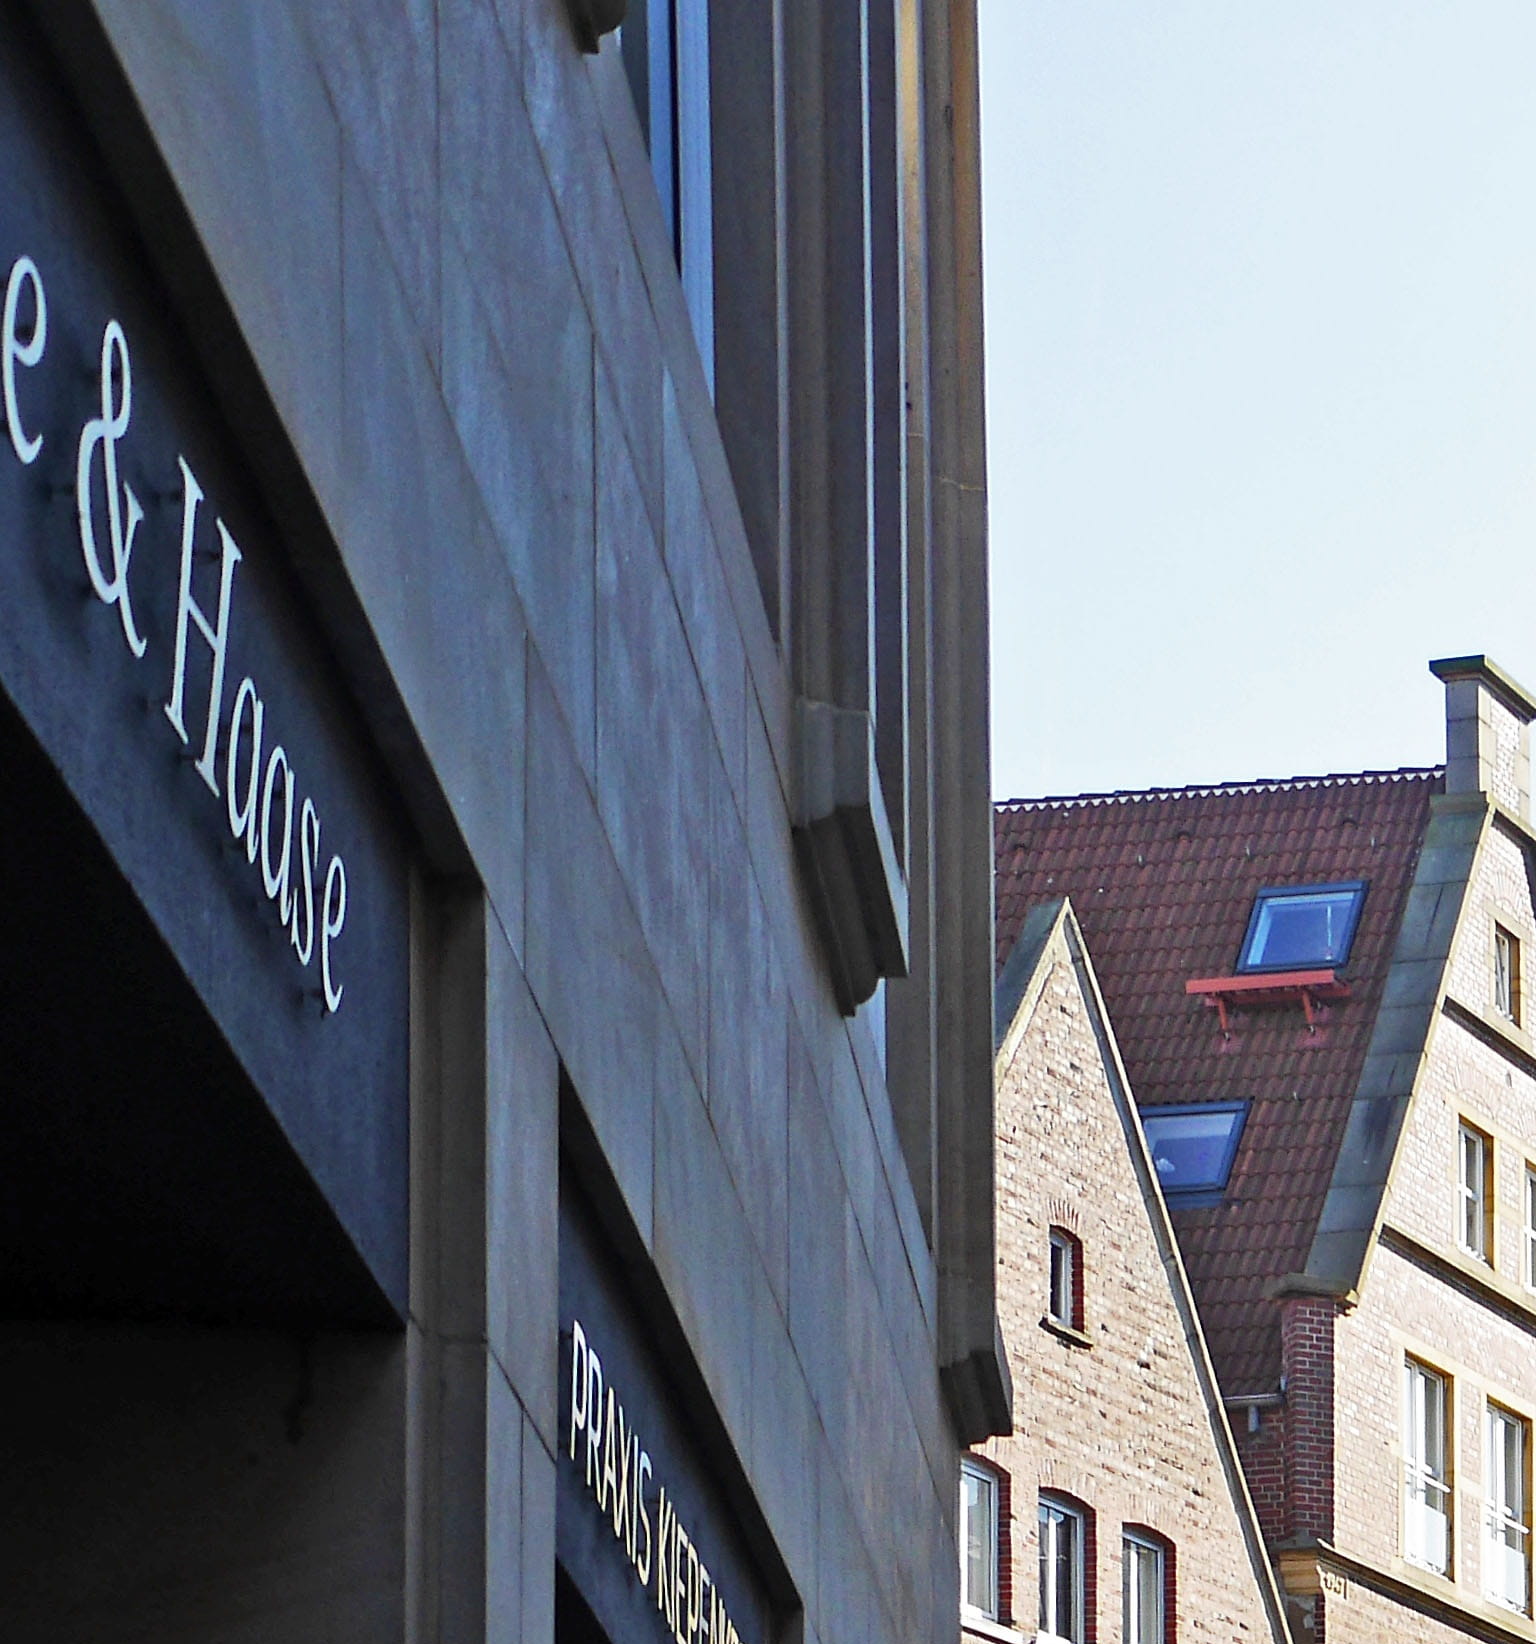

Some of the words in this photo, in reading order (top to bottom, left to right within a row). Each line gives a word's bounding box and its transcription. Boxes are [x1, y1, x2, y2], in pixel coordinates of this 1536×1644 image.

[77, 319, 147, 658] &
[164, 455, 346, 1013] Haase
[569, 1319, 652, 1587] PRAXIS
